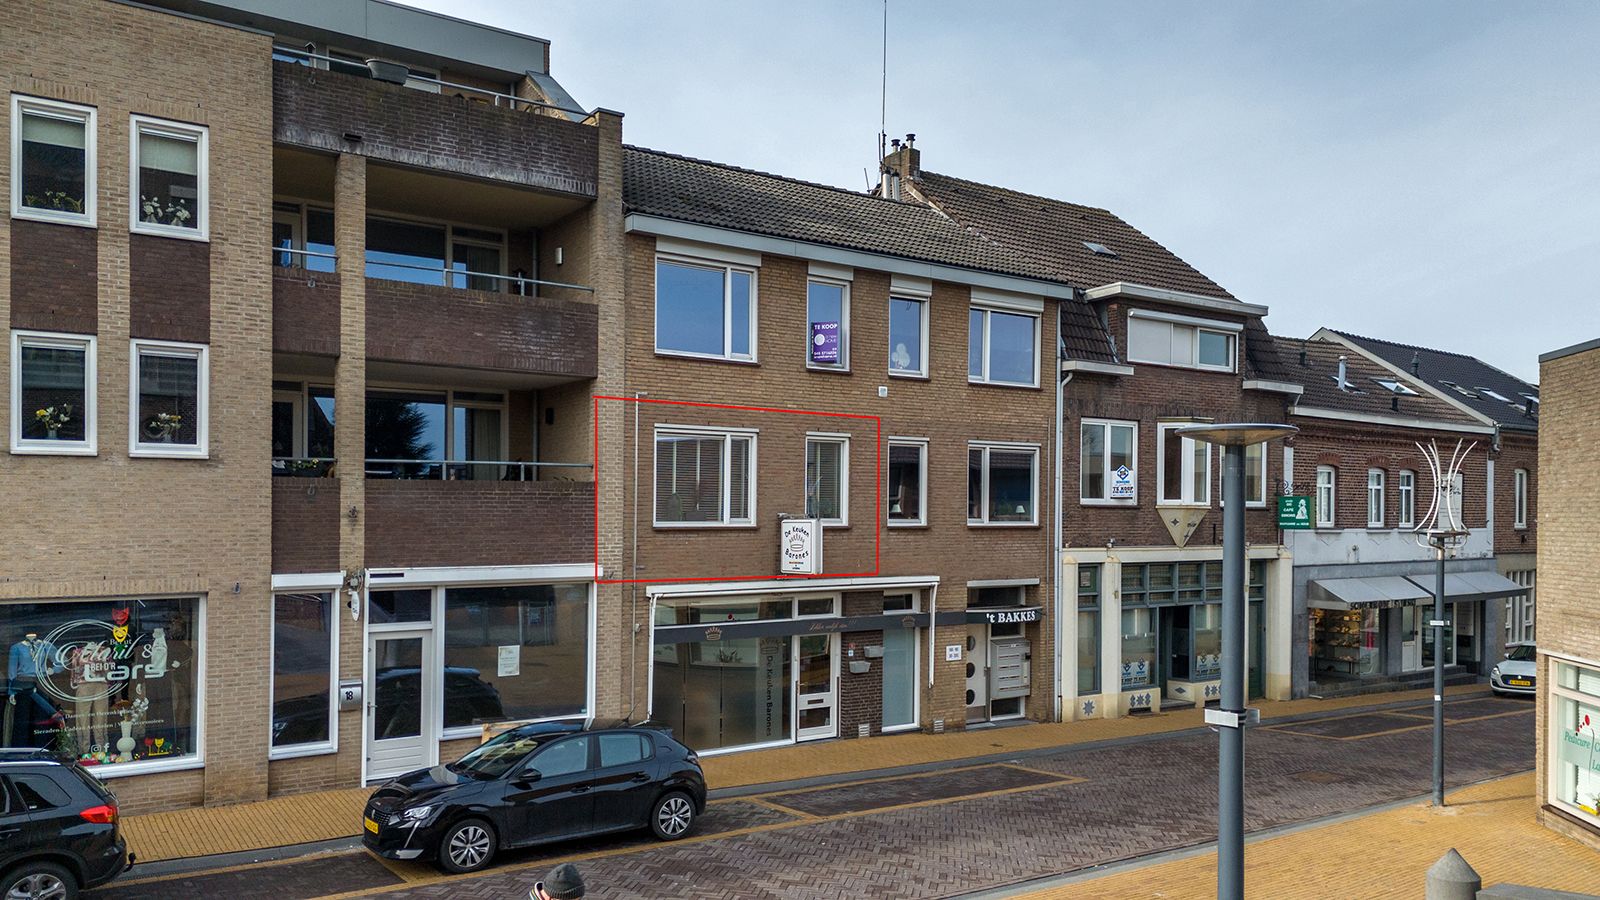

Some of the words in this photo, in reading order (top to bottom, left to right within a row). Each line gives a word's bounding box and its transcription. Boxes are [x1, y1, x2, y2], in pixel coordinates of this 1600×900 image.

[784, 530, 791, 538] De
[792, 526, 810, 538] Keuken
[785, 548, 809, 560] Barones
[986, 613, 995, 623] 't
[998, 611, 1036, 623] BAKKES
[766, 655, 773, 666] De
[84, 664, 165, 681] Lars
[345, 691, 354, 701] 18
[1564, 731, 1591, 749] Pedicure
